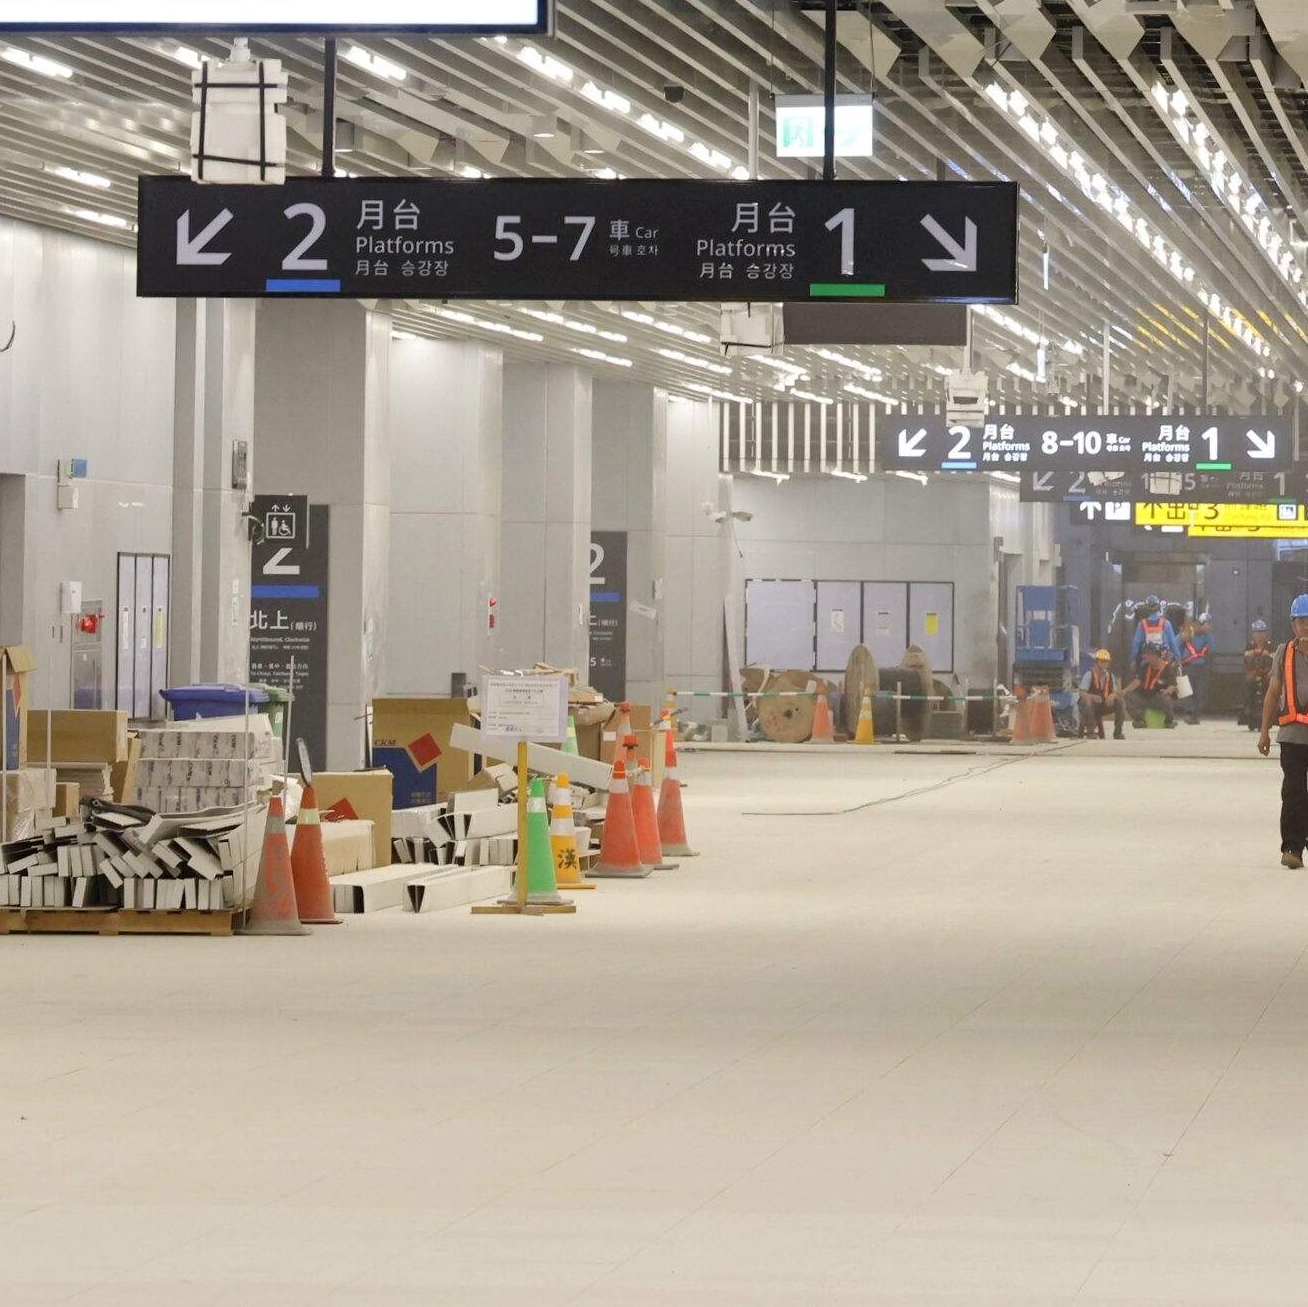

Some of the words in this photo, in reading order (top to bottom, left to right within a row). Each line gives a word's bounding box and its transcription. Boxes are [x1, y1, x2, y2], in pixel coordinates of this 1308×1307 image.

[357, 199, 420, 230] 月台
[732, 202, 795, 233] 月台
[282, 203, 328, 271] 2
[609, 219, 630, 241] 車
[635, 226, 659, 239] Car
[356, 235, 454, 254] Platforms
[697, 238, 796, 258] Platforms
[825, 208, 855, 276] 1
[355, 260, 388, 276] 月台
[402, 259, 449, 277] 승강장
[700, 263, 733, 280] 月台
[746, 262, 794, 280] 승강장
[948, 426, 972, 459] 2
[983, 424, 1014, 441] 月台
[1158, 424, 1191, 441] 月台
[982, 441, 1030, 452] Platforms
[1141, 442, 1191, 453] Platforms
[1202, 426, 1218, 461] 1
[1068, 471, 1087, 494] 2
[1273, 471, 1286, 496] 1
[374, 739, 397, 747] CKM
